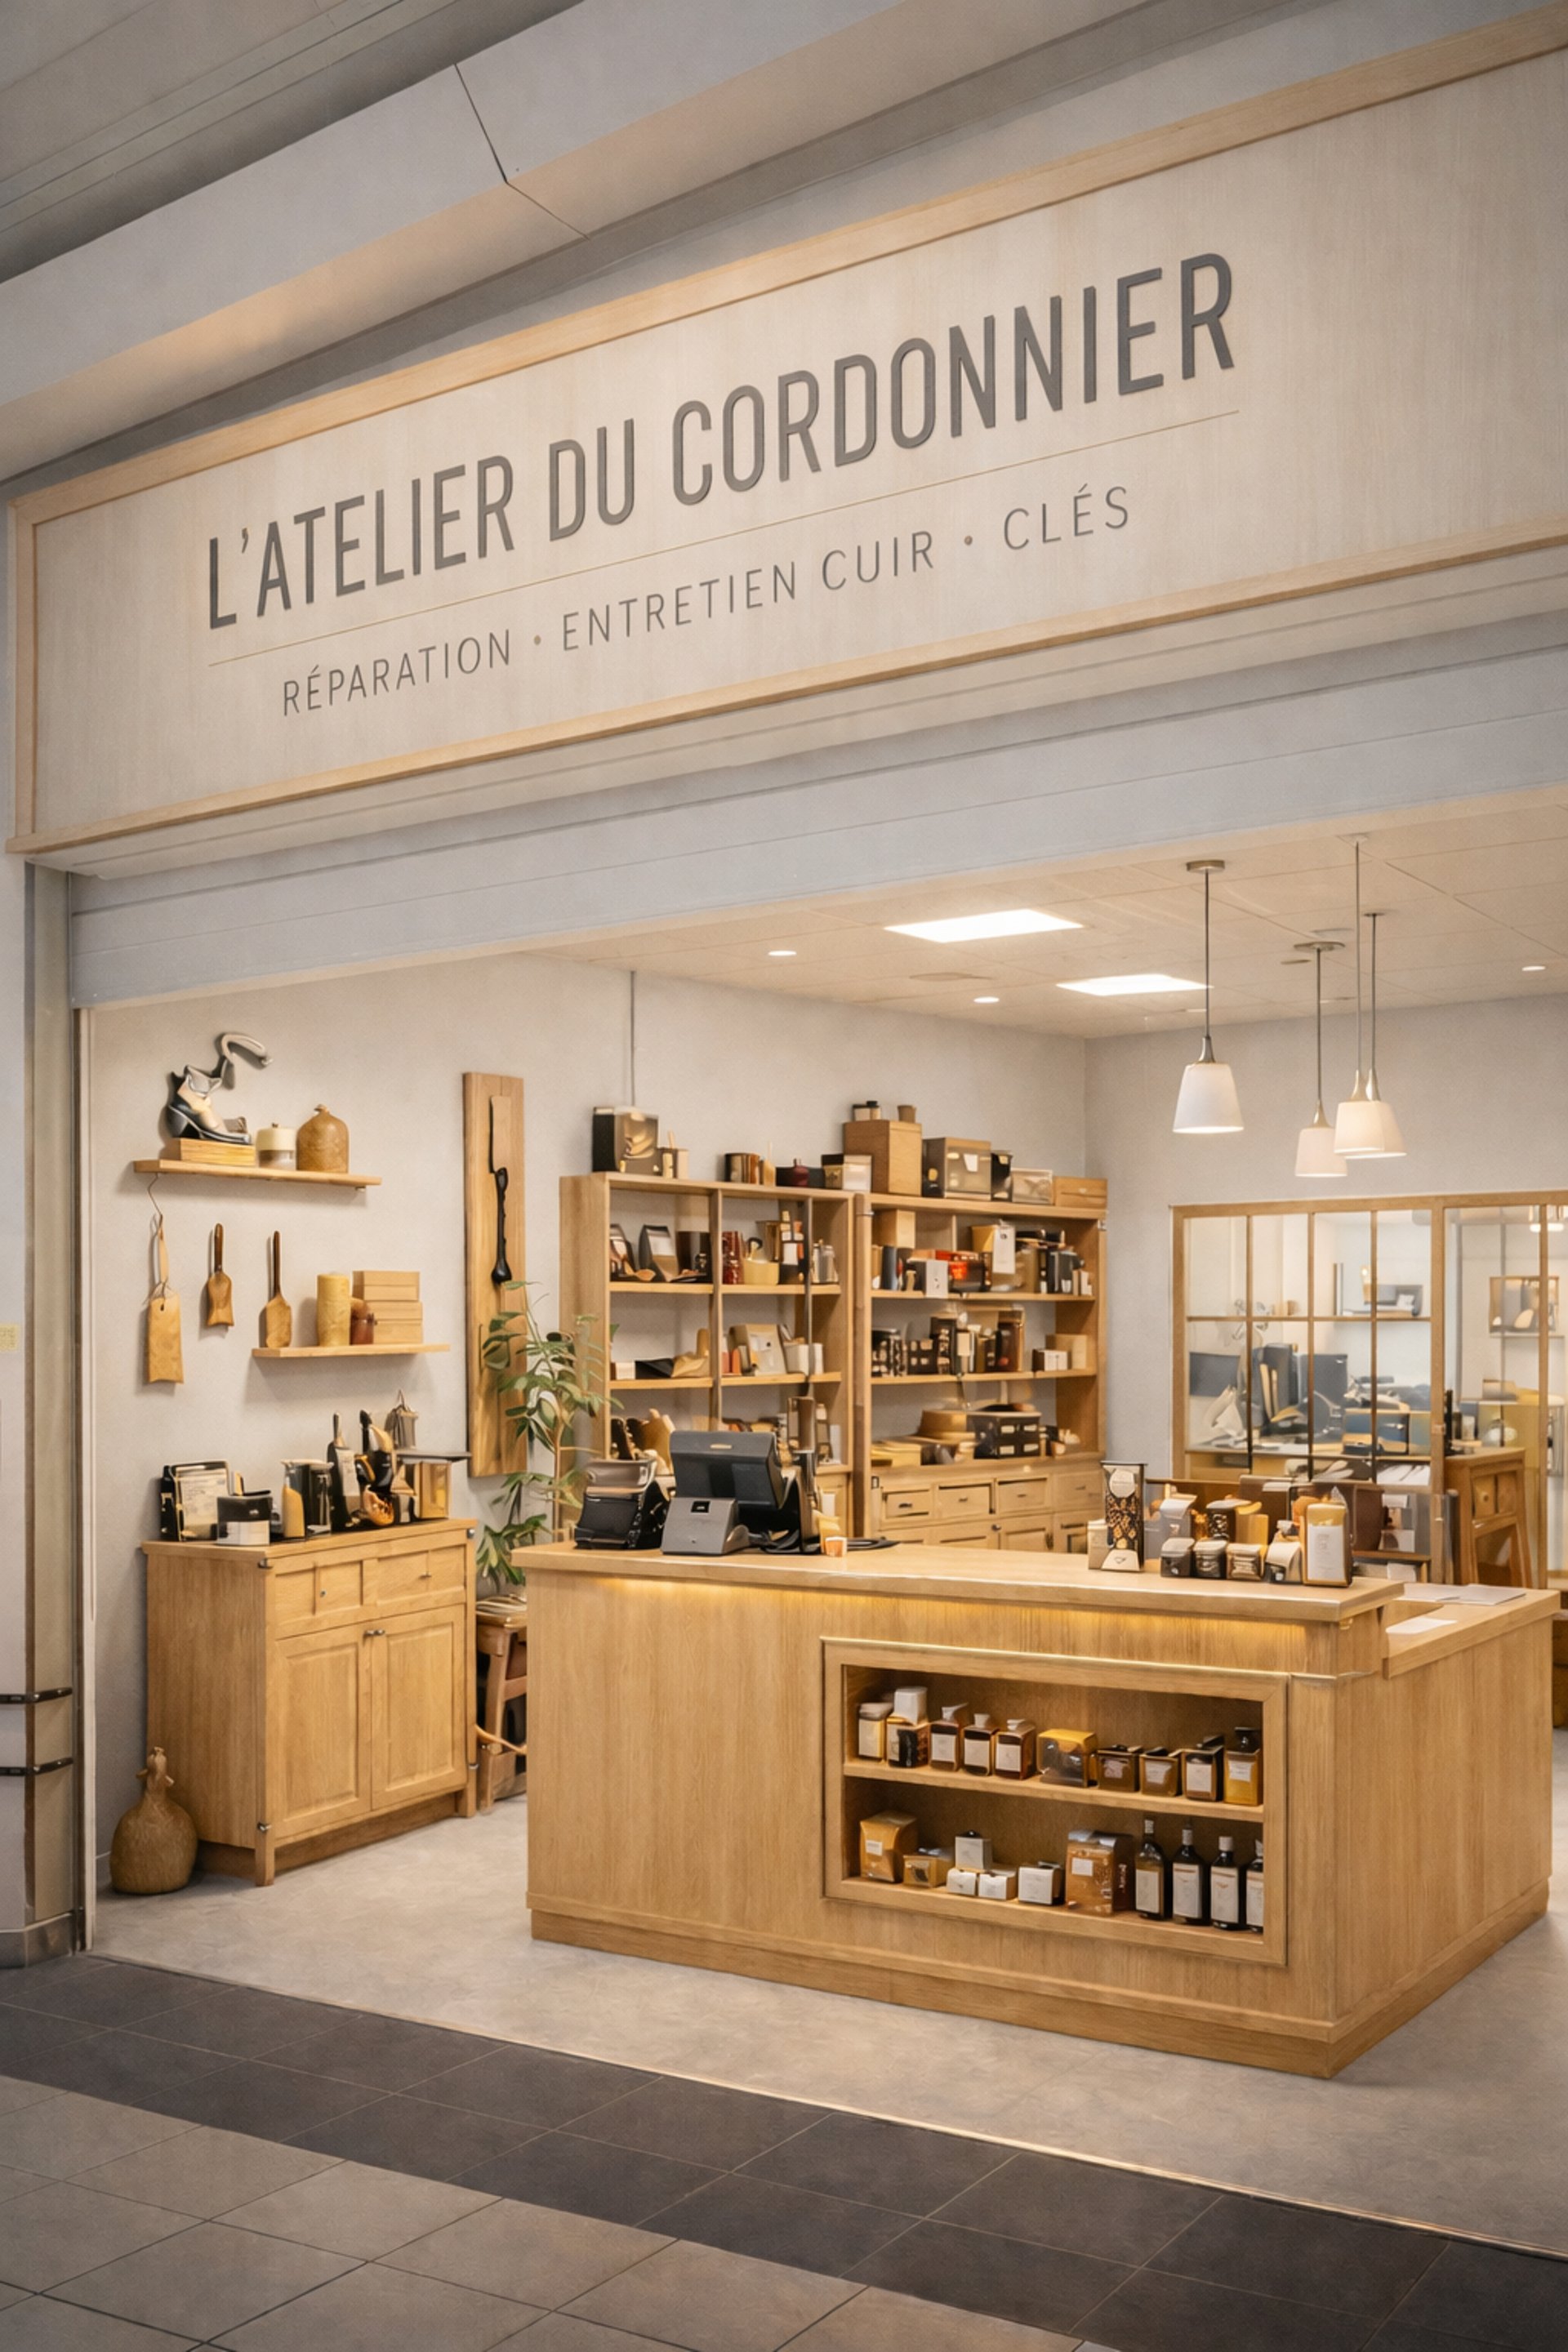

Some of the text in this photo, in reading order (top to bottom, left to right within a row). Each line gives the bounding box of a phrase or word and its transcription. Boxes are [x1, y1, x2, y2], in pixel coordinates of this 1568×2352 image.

[209, 252, 1236, 630] L'ATELIER DU CORDONNIER
[283, 483, 1129, 716] RÉPARATION ENTRETIEN CUIR CLÉS
